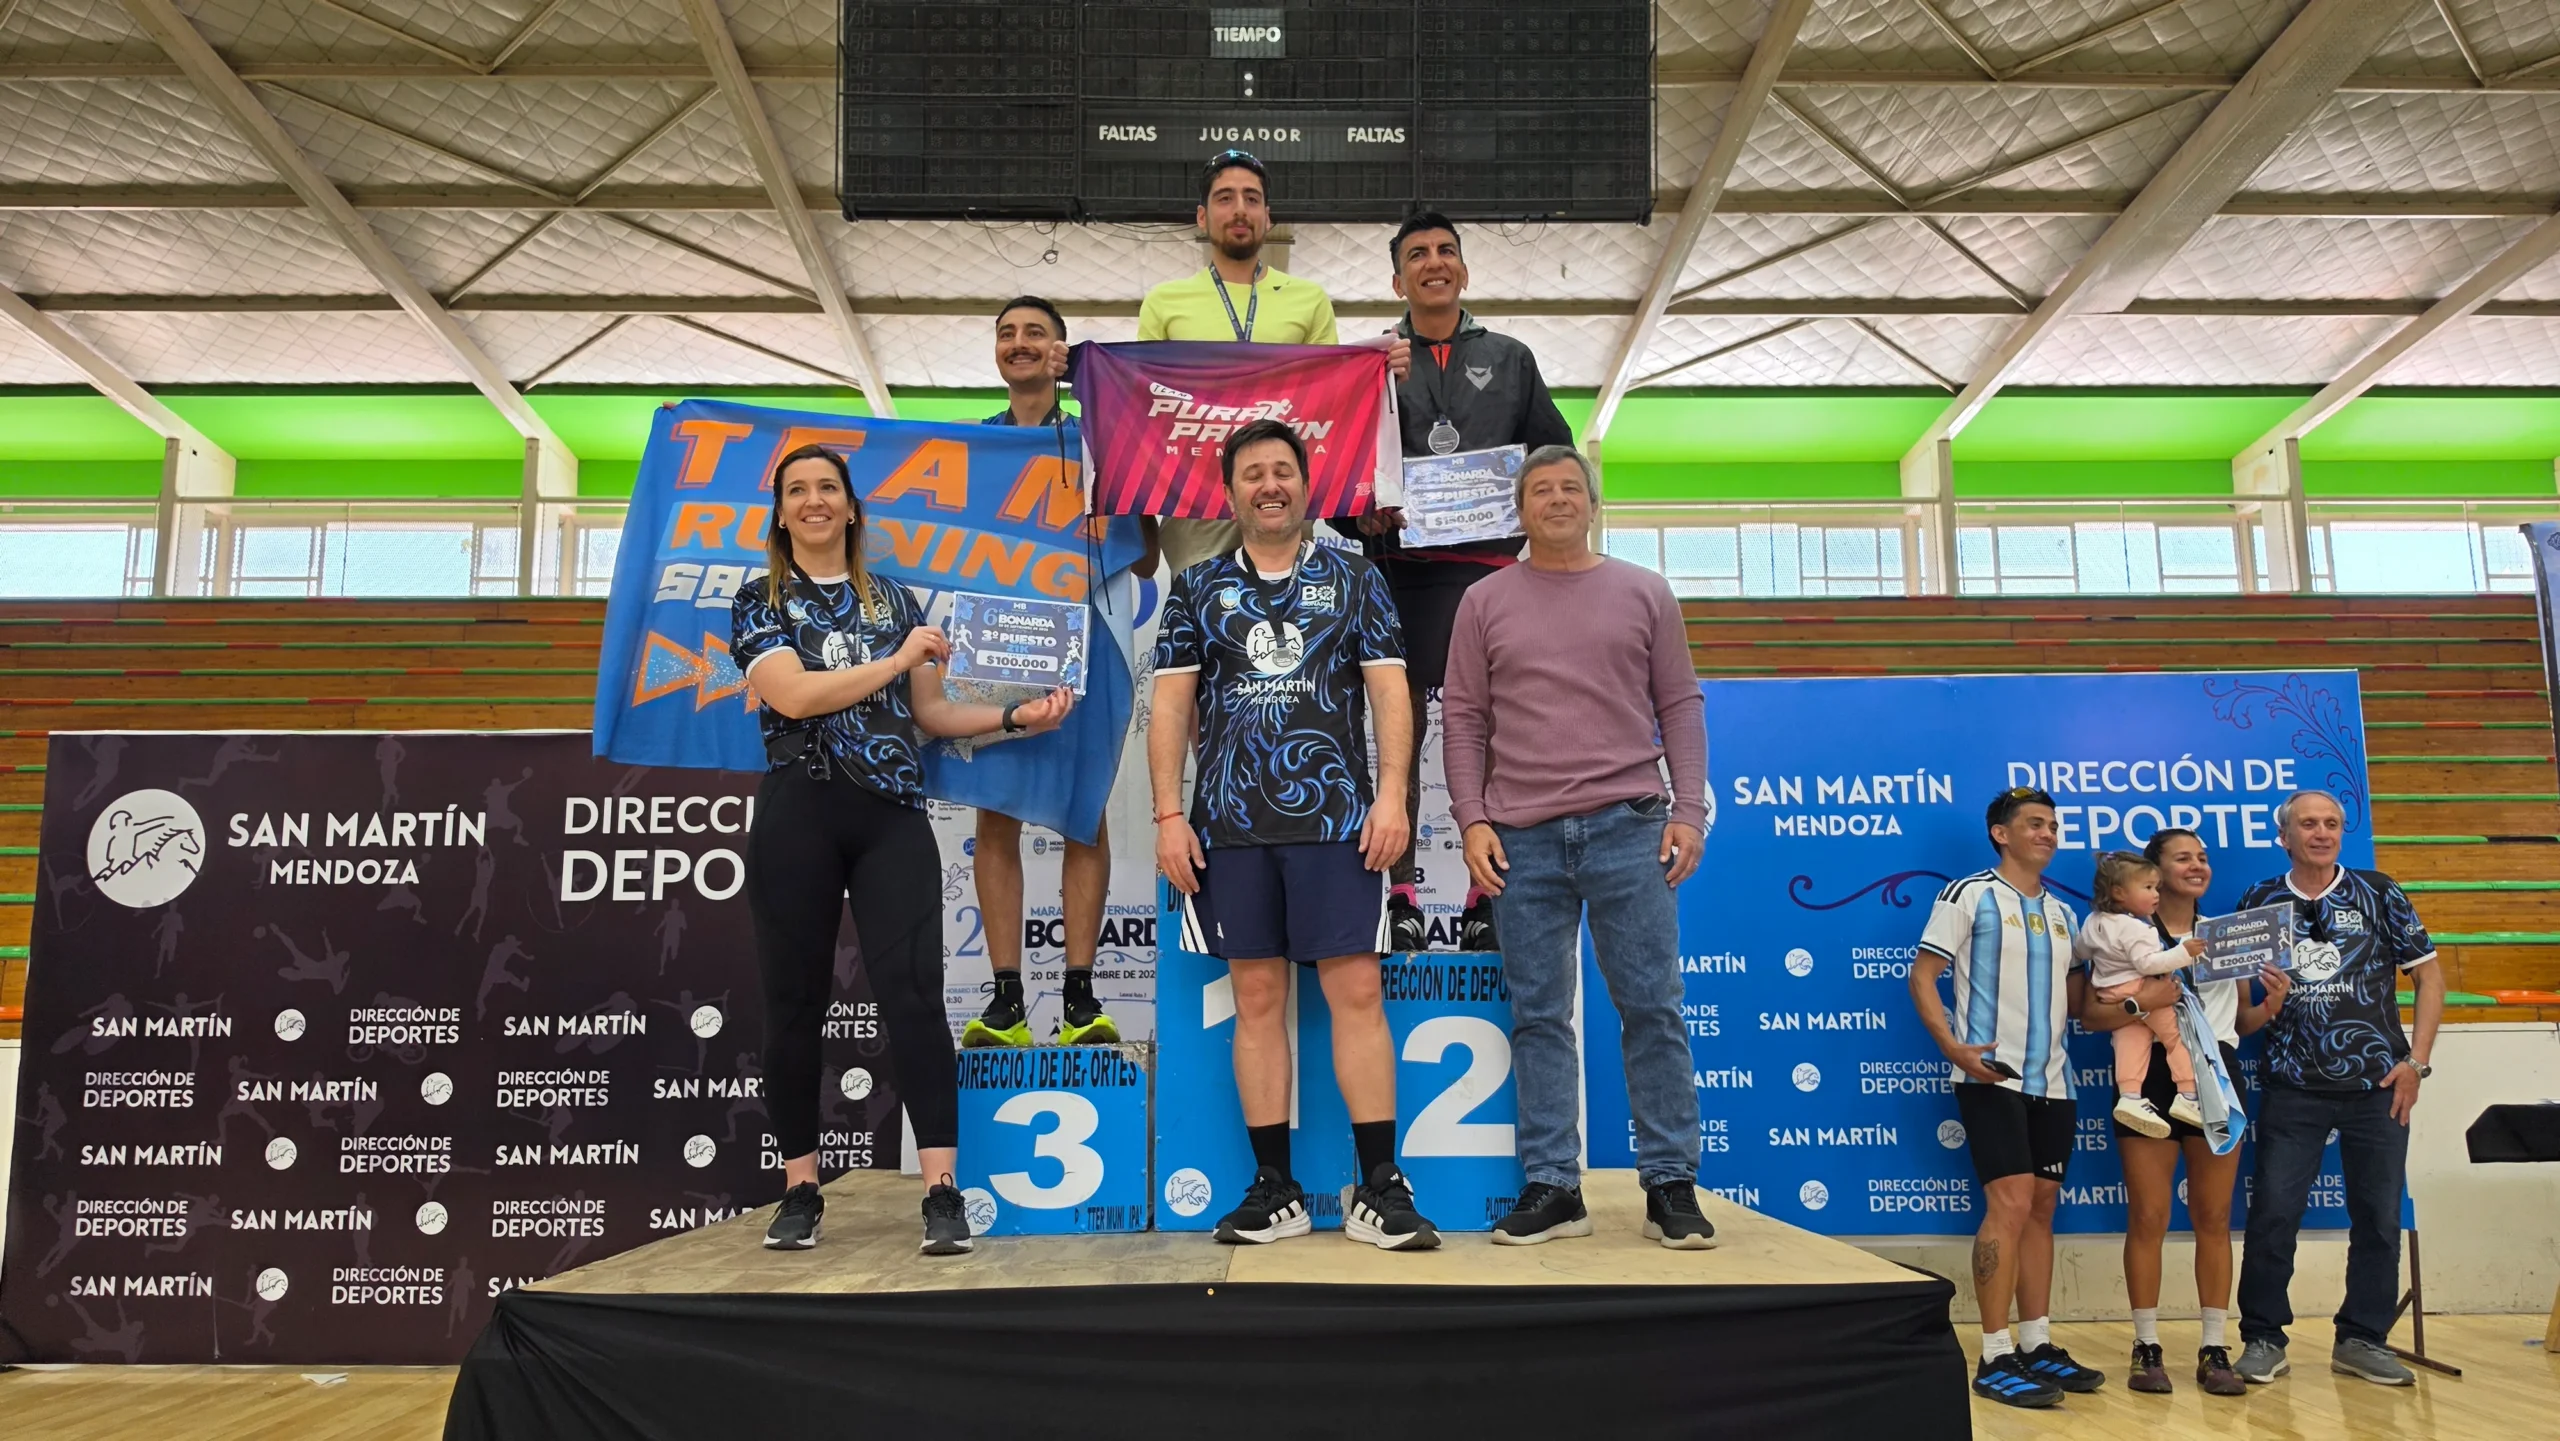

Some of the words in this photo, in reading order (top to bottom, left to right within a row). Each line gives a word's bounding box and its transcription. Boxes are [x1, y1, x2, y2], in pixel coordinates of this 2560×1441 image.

[1214, 26, 1281, 43] TIEMPO
[1099, 125, 1157, 142] FALTAS
[1199, 127, 1301, 142] JUGADOR
[1347, 127, 1405, 143] FALTAS
[1154, 384, 1187, 399] TEAM
[1168, 417, 1334, 442] PAN
[1166, 445, 1327, 458] MENA
[670, 503, 1098, 604] RUNING
[1013, 602, 1027, 610] MB
[998, 613, 1056, 629] BONARDA
[999, 632, 1057, 648] PUESTO
[986, 654, 1049, 669] $100.000
[1237, 681, 1260, 695] SAN
[1263, 676, 1316, 693] MARTÍN
[1250, 696, 1300, 705] MENDOZA
[2007, 753, 2235, 793] DIRECCIÓN
[2243, 758, 2298, 791] DE
[1735, 776, 1803, 805] SAN
[1815, 767, 1953, 805] MARTÍN
[564, 796, 754, 834] DIRECCI
[227, 812, 309, 848] SAN
[325, 803, 487, 848] MARTÍN
[1775, 814, 1903, 837] MENDOZA
[2055, 803, 2284, 850] EPORTE
[270, 858, 420, 885] MENDOZA
[560, 848, 746, 902] DEPO
[1030, 906, 1064, 917] MARA
[2226, 919, 2269, 934] BONARDA
[2226, 933, 2271, 948] PUESTO
[1852, 945, 1919, 960] DIRECCIÓ
[1678, 952, 1746, 974] ARTÍN
[1030, 971, 1043, 980] 20
[1046, 971, 1060, 980] DE
[1123, 970, 1136, 979] DE
[1138, 969, 1157, 979] 202
[1380, 956, 1443, 1001] RECCIÓN
[1447, 965, 1467, 1001] DE
[1470, 965, 1512, 1002] DEPO
[2310, 981, 2355, 994] MARTÍN
[350, 1005, 437, 1022] DIRECCIÓN
[439, 1008, 461, 1022] DE
[857, 1003, 878, 1017] DE
[1703, 1005, 1719, 1017] DE
[92, 1017, 138, 1038] SAN
[144, 1013, 232, 1037] MARTÍN
[504, 1016, 549, 1036] SAN
[558, 1010, 646, 1036] MARTÍN
[1053, 1016, 1060, 1024] N
[1759, 1012, 1800, 1031] SAN
[1807, 1008, 1887, 1030] MARTÍN
[348, 1026, 460, 1044] DEPORTES
[822, 1020, 878, 1039] RTES
[1039, 1051, 1058, 1088] DE
[1860, 1059, 1938, 1074] DIRECCIÓN
[1941, 1061, 1953, 1074] D
[85, 1069, 171, 1086] DIRECCIÓN
[174, 1072, 195, 1086] DE
[497, 1068, 584, 1085] DIRECCIÓN
[586, 1070, 610, 1084] DE
[1694, 1066, 1753, 1088] ARTÍN
[1861, 1077, 1953, 1094] DEPORTE
[237, 1081, 283, 1102] SAN
[290, 1077, 378, 1102] MARTÍN
[653, 1078, 700, 1099] SAN
[707, 1077, 766, 1098] MAR
[1401, 1015, 1516, 1157] 2
[83, 1089, 194, 1108] DEPORTES
[496, 1087, 609, 1108] DEPORTES
[1709, 1120, 1728, 1132] DE
[2087, 1119, 2106, 1131] DE
[340, 1134, 428, 1151] DIRECCIÓN
[430, 1137, 452, 1151] DE
[852, 1132, 874, 1146] DE
[1769, 1127, 1810, 1146] SAN
[1817, 1123, 1898, 1146] MARTÍN
[80, 1145, 127, 1166] SAN
[134, 1141, 222, 1166] MARTÍN
[496, 1145, 541, 1166] SAN
[549, 1140, 639, 1165] MARTÍN
[989, 1090, 1105, 1210] 3
[339, 1155, 451, 1174] DEPORTES
[1868, 1176, 1947, 1192] DIRECCIÓN
[1950, 1179, 1970, 1192] DE
[2324, 1175, 2344, 1188] DE
[2060, 1182, 2129, 1205] MARTÍ
[76, 1198, 164, 1215] DIRECCIÓN
[166, 1201, 188, 1215] DE
[493, 1198, 580, 1215] DIRECCIÓN
[584, 1200, 605, 1214] DE
[1870, 1195, 1972, 1212] DEPORTES
[230, 1209, 277, 1230] SAN
[284, 1205, 372, 1230] MARTÍN
[649, 1208, 695, 1229] SAN
[75, 1218, 187, 1238] DEPORTES
[492, 1217, 605, 1238] DEPORTES
[332, 1265, 420, 1282] DIRECCIÓN
[422, 1268, 444, 1282] DE
[70, 1276, 117, 1297] SAN
[123, 1272, 213, 1297] MARTÍN
[331, 1286, 443, 1305] DEPORTES
